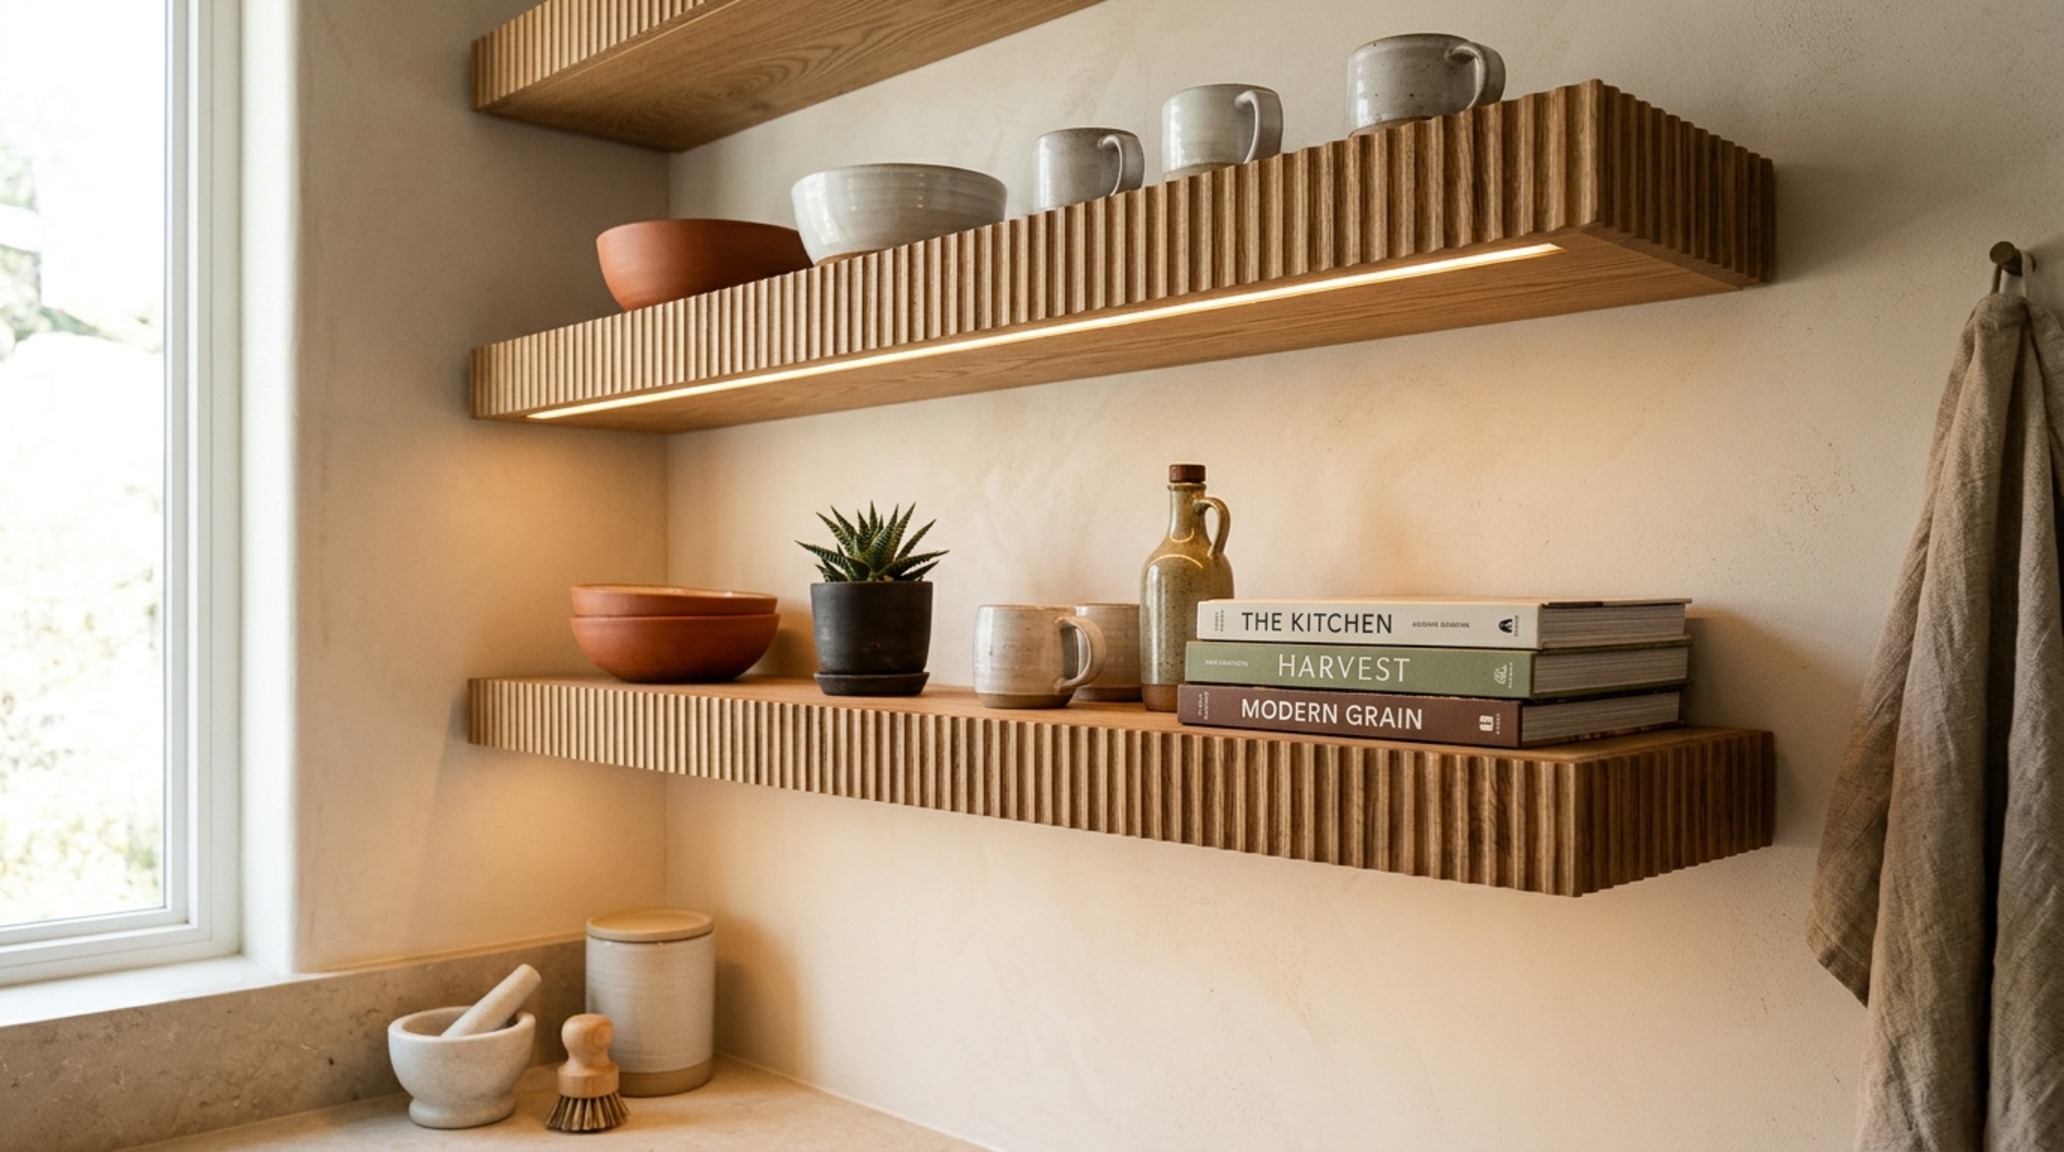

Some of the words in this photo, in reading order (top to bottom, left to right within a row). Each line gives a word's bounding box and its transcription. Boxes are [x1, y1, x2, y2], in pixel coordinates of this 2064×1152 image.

[1241, 612, 1282, 632] THE
[1291, 612, 1392, 634] KITCHEN
[1278, 653, 1411, 683] HARVEST
[1241, 698, 1338, 725] MODERN
[1345, 704, 1423, 731] GRAIN
